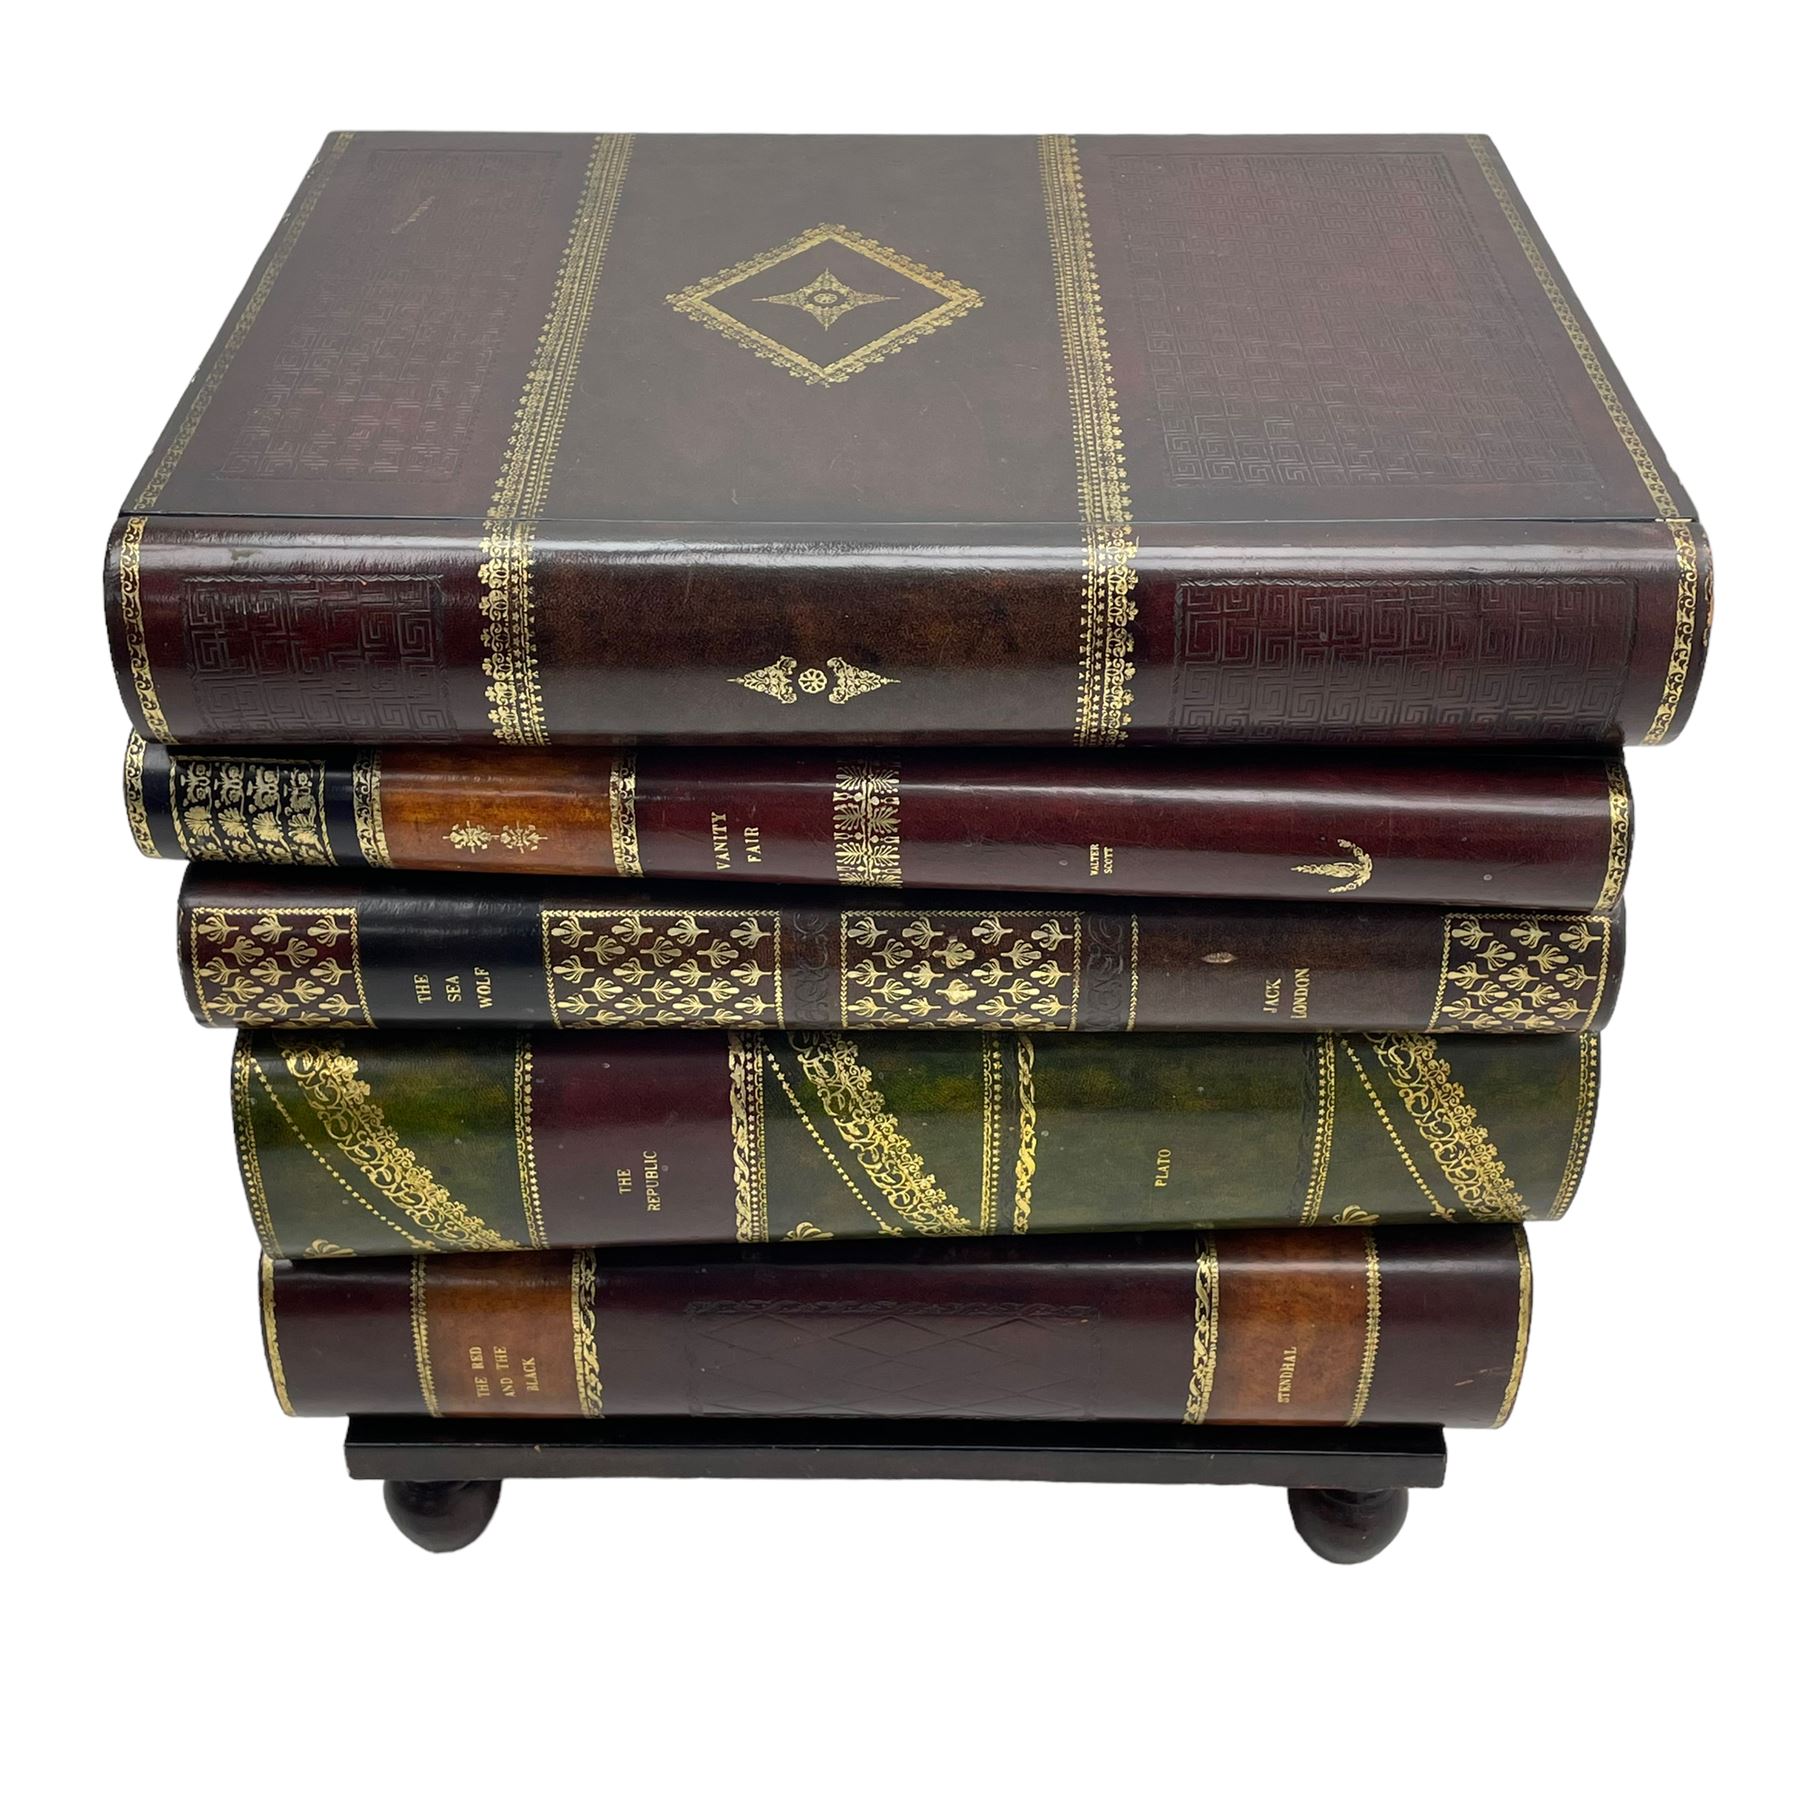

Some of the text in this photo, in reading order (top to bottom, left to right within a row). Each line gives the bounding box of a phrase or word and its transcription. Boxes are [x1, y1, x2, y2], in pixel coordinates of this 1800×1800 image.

[711, 811, 731, 872] VANITY
[743, 826, 763, 865] FAIR
[1089, 842, 1100, 876] WALTER
[1102, 846, 1114, 875] SCOTT
[413, 973, 432, 1004] THE
[445, 974, 462, 1003] SEA
[474, 966, 493, 1010] WOLF
[1262, 977, 1282, 1014] JACK
[1290, 967, 1310, 1019] LONDON
[616, 1168, 632, 1196] THE
[643, 1151, 661, 1212] REPUBLIC
[1153, 1148, 1172, 1188] PLATO
[468, 1345, 490, 1399] THE RED
[493, 1344, 515, 1399] AND THE
[522, 1356, 540, 1392] BLACK
[1277, 1346, 1298, 1404] STENDHAL
